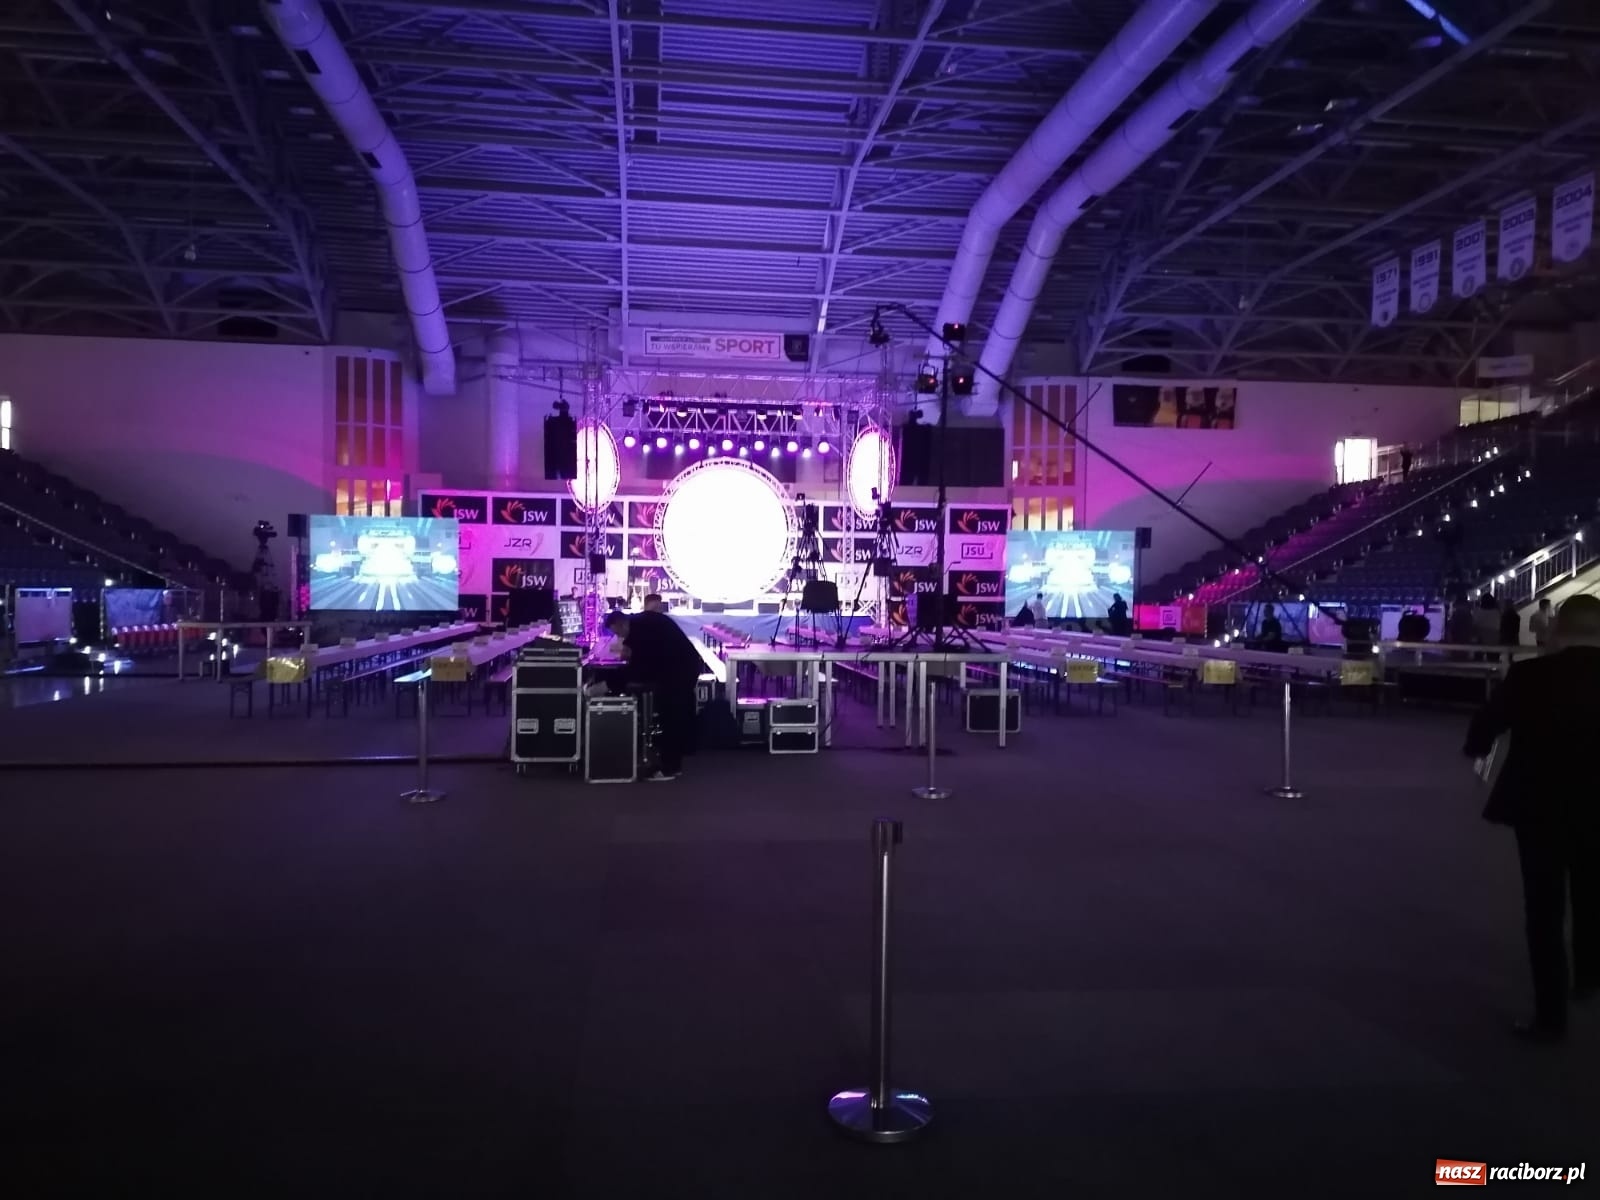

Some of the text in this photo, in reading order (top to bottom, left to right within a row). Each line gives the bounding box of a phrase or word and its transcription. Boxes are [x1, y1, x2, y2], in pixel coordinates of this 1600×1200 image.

[1555, 184, 1592, 210] 2004
[1414, 249, 1438, 268] 1991
[1376, 268, 1397, 284] 1971
[714, 338, 775, 354] SPORT
[453, 508, 479, 520] JSW
[522, 510, 548, 523] JSW
[855, 517, 874, 529] SW
[914, 519, 937, 531] JSW
[976, 520, 1000, 533] JSW
[503, 538, 532, 548] JZR
[855, 549, 872, 560] SW
[897, 545, 923, 555] JZR
[965, 546, 985, 556] JSU
[521, 575, 548, 588] JSW
[913, 582, 937, 594] JSW
[976, 582, 999, 595] JSW
[976, 613, 997, 625] JSW
